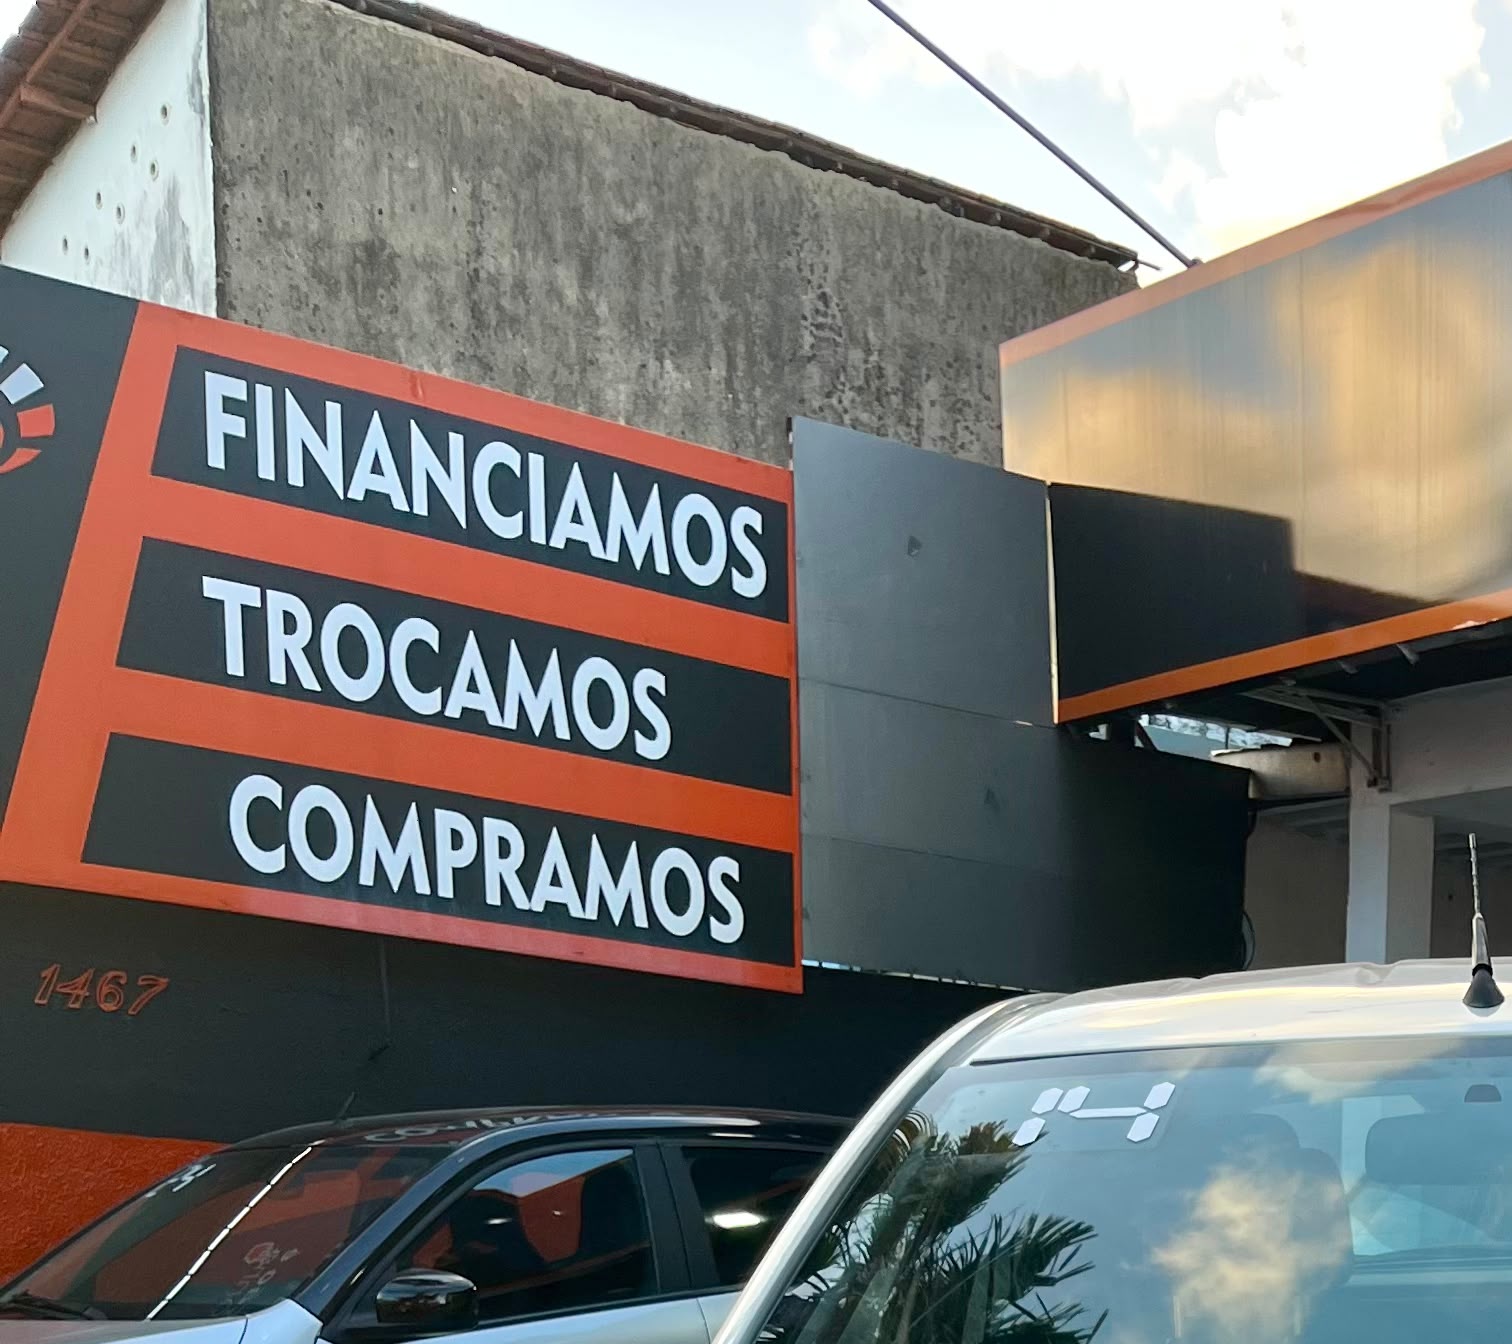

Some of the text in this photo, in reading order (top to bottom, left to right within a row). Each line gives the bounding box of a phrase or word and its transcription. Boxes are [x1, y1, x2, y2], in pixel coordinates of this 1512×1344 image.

[203, 369, 768, 598] FINANCIAMOS
[201, 574, 673, 761] TROCAMOS
[228, 773, 746, 945] COMPRAMOS
[33, 962, 170, 1017] 1467
